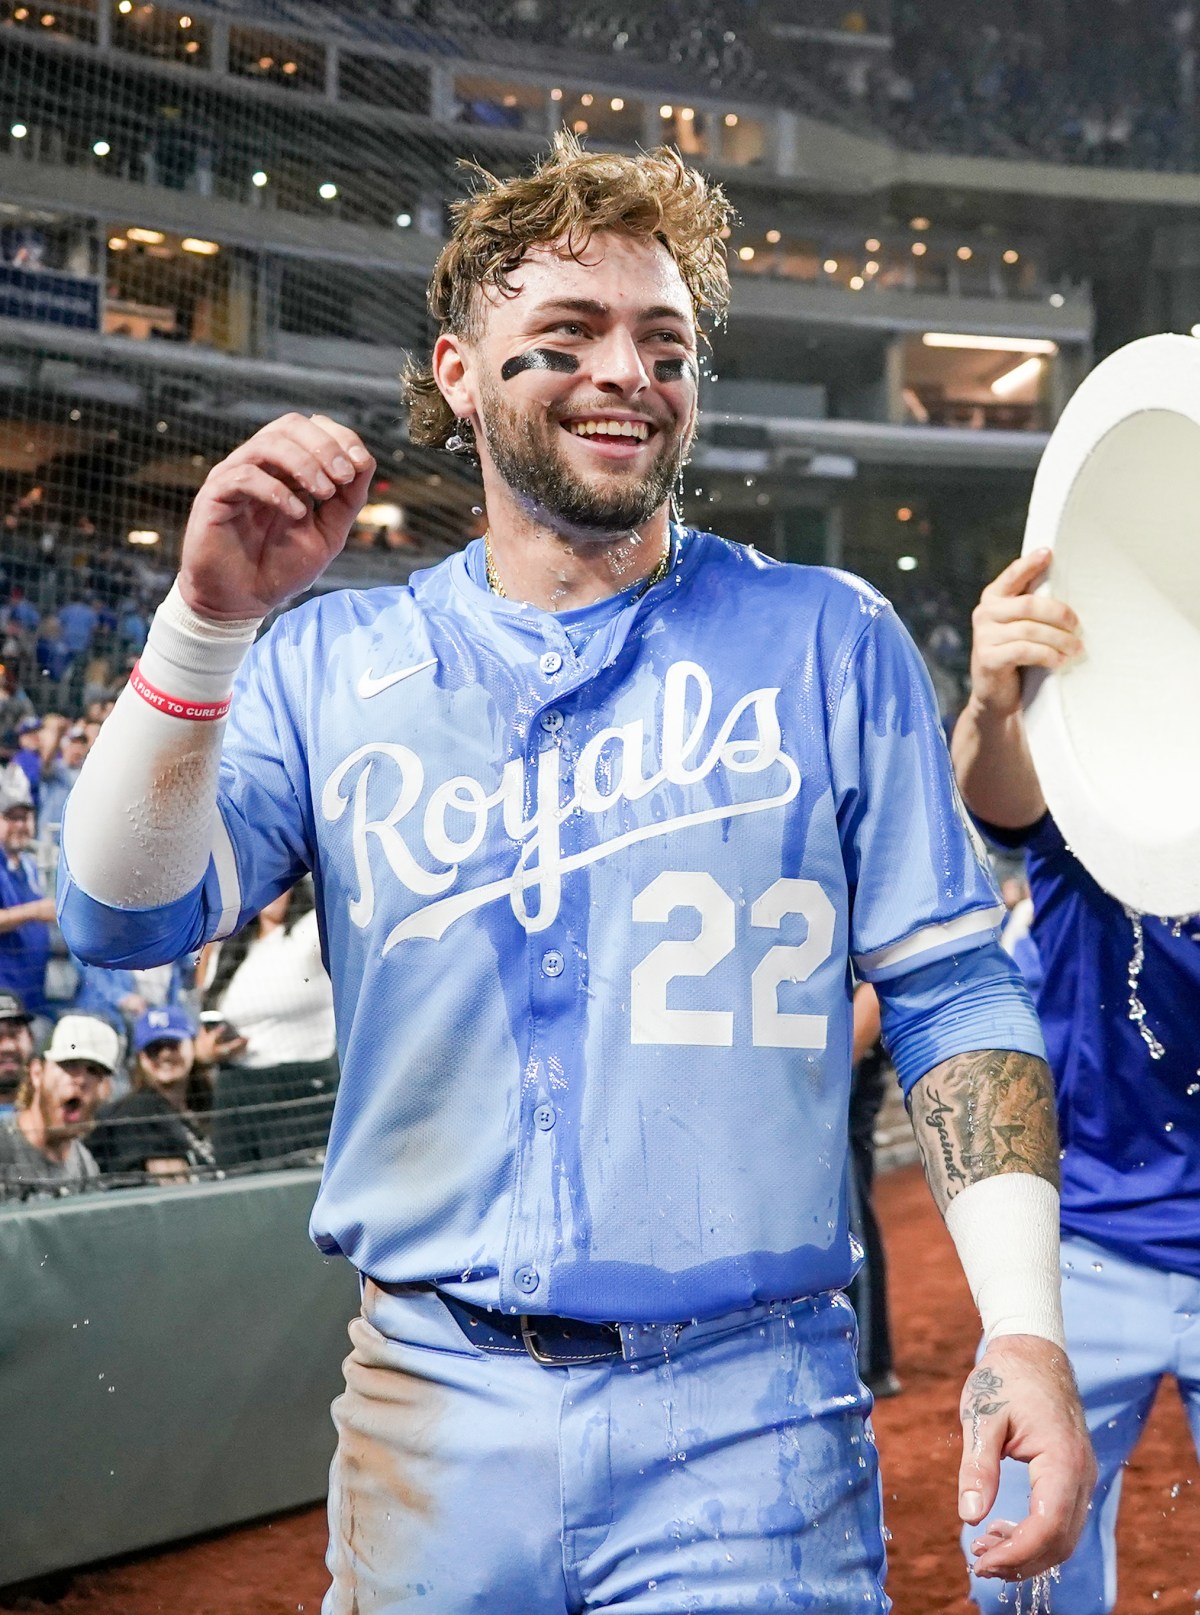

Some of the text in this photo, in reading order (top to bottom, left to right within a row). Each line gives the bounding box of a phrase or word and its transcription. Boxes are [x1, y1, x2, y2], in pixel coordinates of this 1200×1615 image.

[136, 683, 166, 706] FIGHT
[167, 701, 184, 713] TO
[186, 707, 215, 717] CURE
[322, 660, 802, 957] Royals
[630, 870, 837, 1048] 22
[925, 1085, 966, 1190] Against
